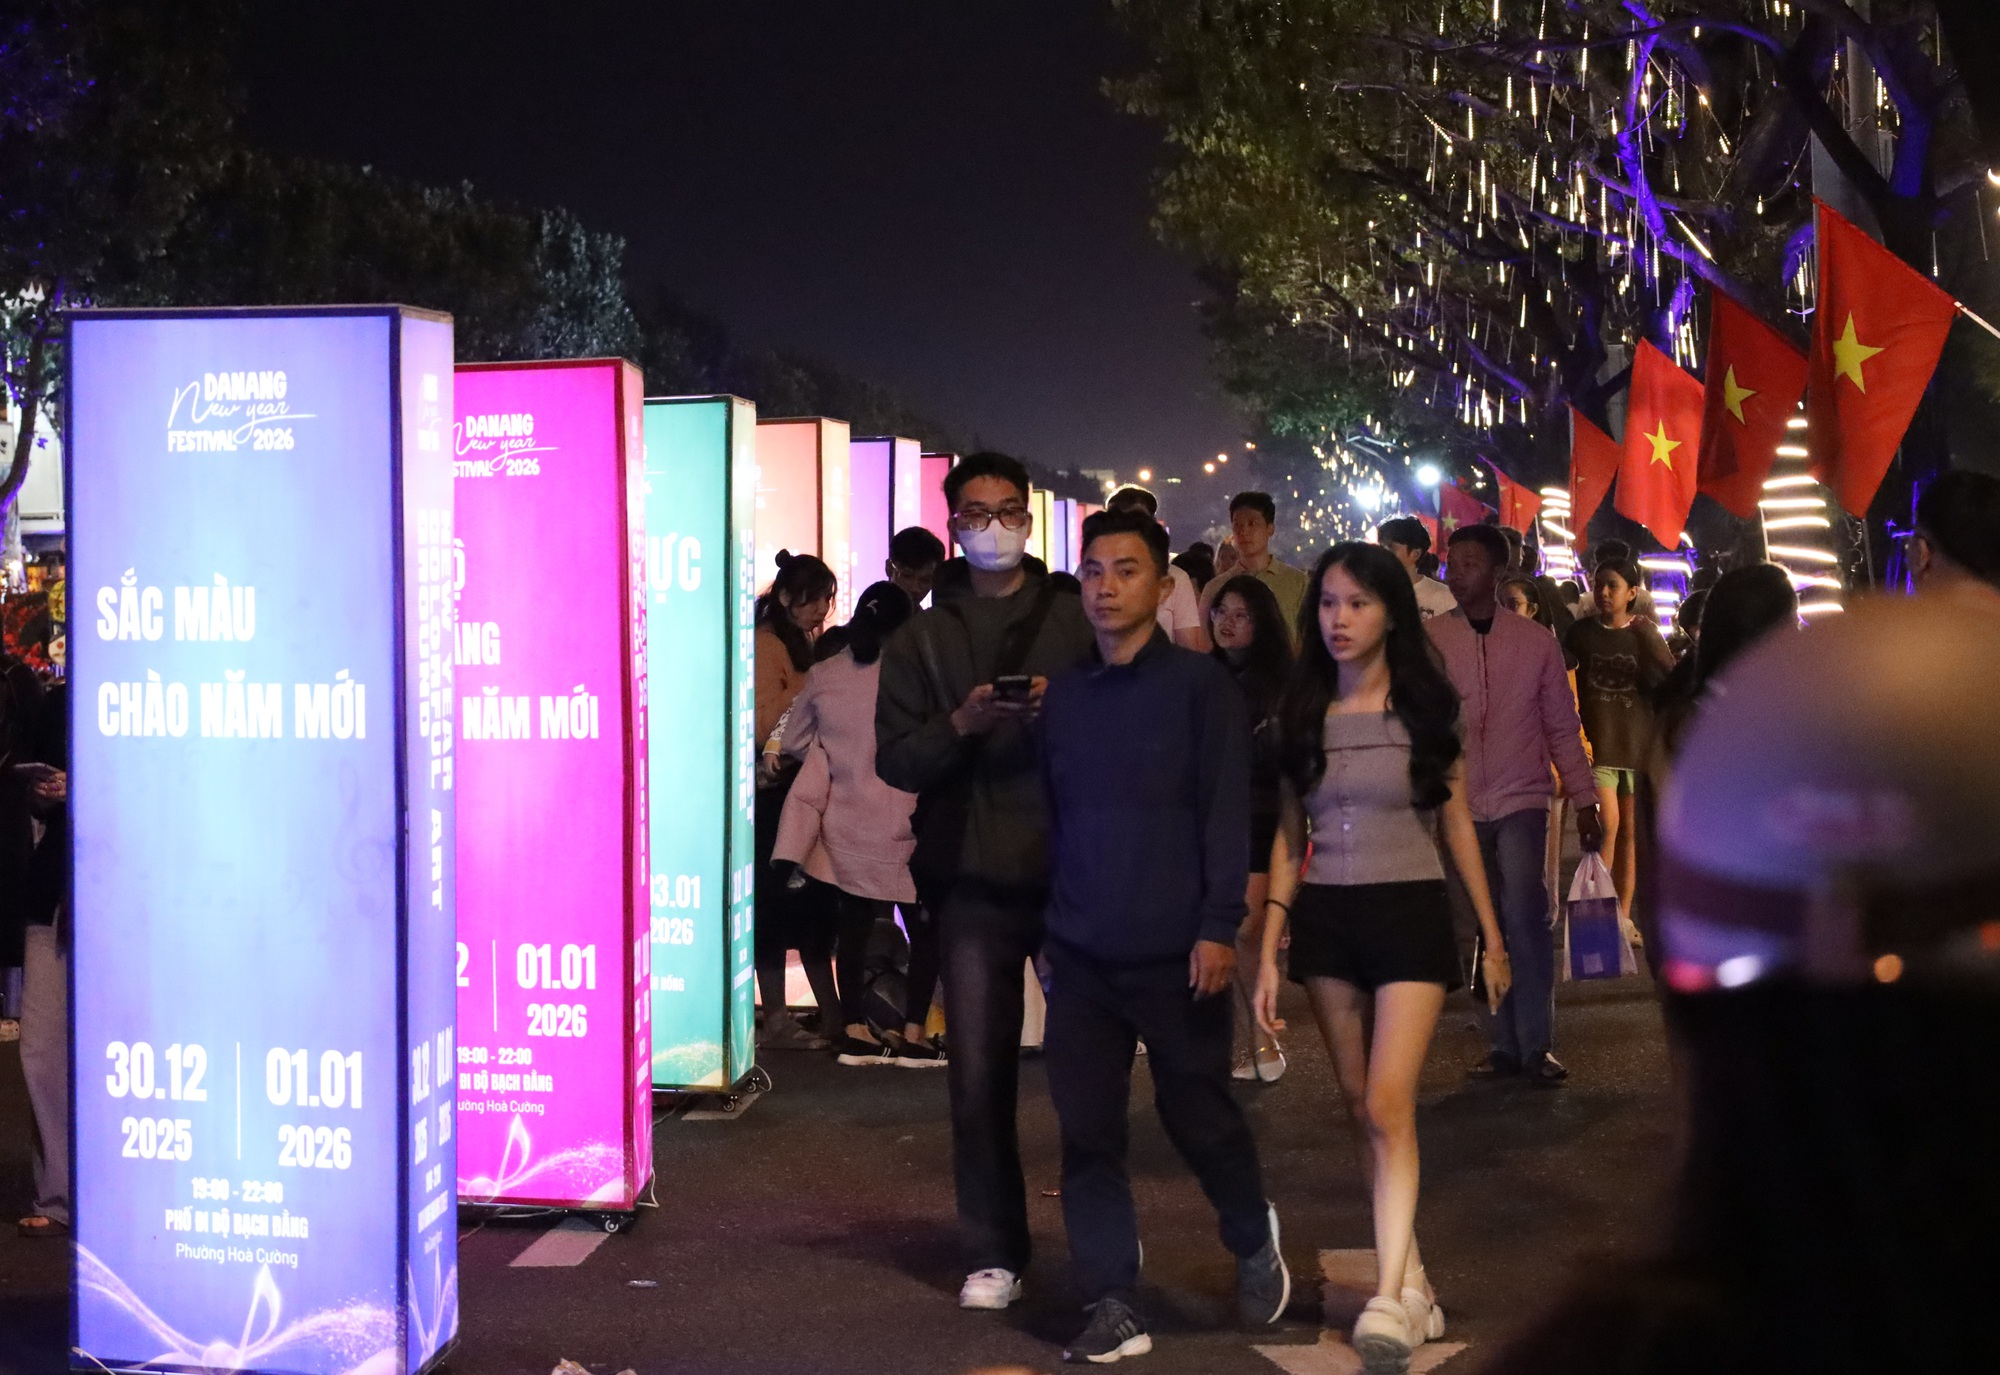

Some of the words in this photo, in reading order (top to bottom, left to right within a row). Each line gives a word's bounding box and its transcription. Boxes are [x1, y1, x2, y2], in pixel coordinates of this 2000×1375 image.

[168, 380, 241, 429] New
[205, 371, 287, 401] DANANG
[168, 429, 237, 452] FESTIVAL
[253, 427, 294, 450] 2026
[466, 413, 534, 438] DANANG
[454, 460, 494, 478] STIVAL
[506, 458, 541, 476] 2026
[441, 509, 453, 631] NEW
[454, 538, 466, 600] Ộ
[646, 532, 701, 604] ỰC
[97, 567, 163, 641] SẮC
[175, 573, 255, 641] MÀU
[455, 609, 501, 665] NG
[98, 669, 188, 737] CHÀO
[201, 670, 282, 739] NĂM
[295, 669, 365, 740] MỚI
[441, 653, 453, 790] YEAR
[462, 686, 530, 740] NĂM
[540, 684, 599, 740] MỚI
[430, 809, 442, 910] ART
[650, 916, 694, 945] 2026
[517, 943, 596, 989] 01.01
[527, 1004, 587, 1038] 2026
[106, 1041, 207, 1102] 30.12
[266, 1047, 362, 1109] 01.01
[457, 1046, 488, 1064] 19:00
[498, 1047, 532, 1065] 22:00
[473, 1070, 489, 1094] BỘ
[491, 1073, 521, 1095] BẠCH
[523, 1070, 553, 1092] ĐẰNG
[457, 1100, 484, 1115] ường
[486, 1100, 508, 1112] Hoà
[510, 1100, 545, 1116] Cường
[122, 1117, 192, 1161] 2025
[278, 1125, 351, 1169] 2026
[192, 1177, 230, 1201] 19:00
[242, 1180, 283, 1204] 22:00
[165, 1206, 193, 1232] PHỐ
[212, 1208, 230, 1239] BỘ
[234, 1213, 269, 1240] BẠCH
[272, 1209, 309, 1239] ĐẰNG
[176, 1243, 225, 1265] Phường
[228, 1247, 253, 1263] Hoà
[256, 1248, 298, 1269] Cường
